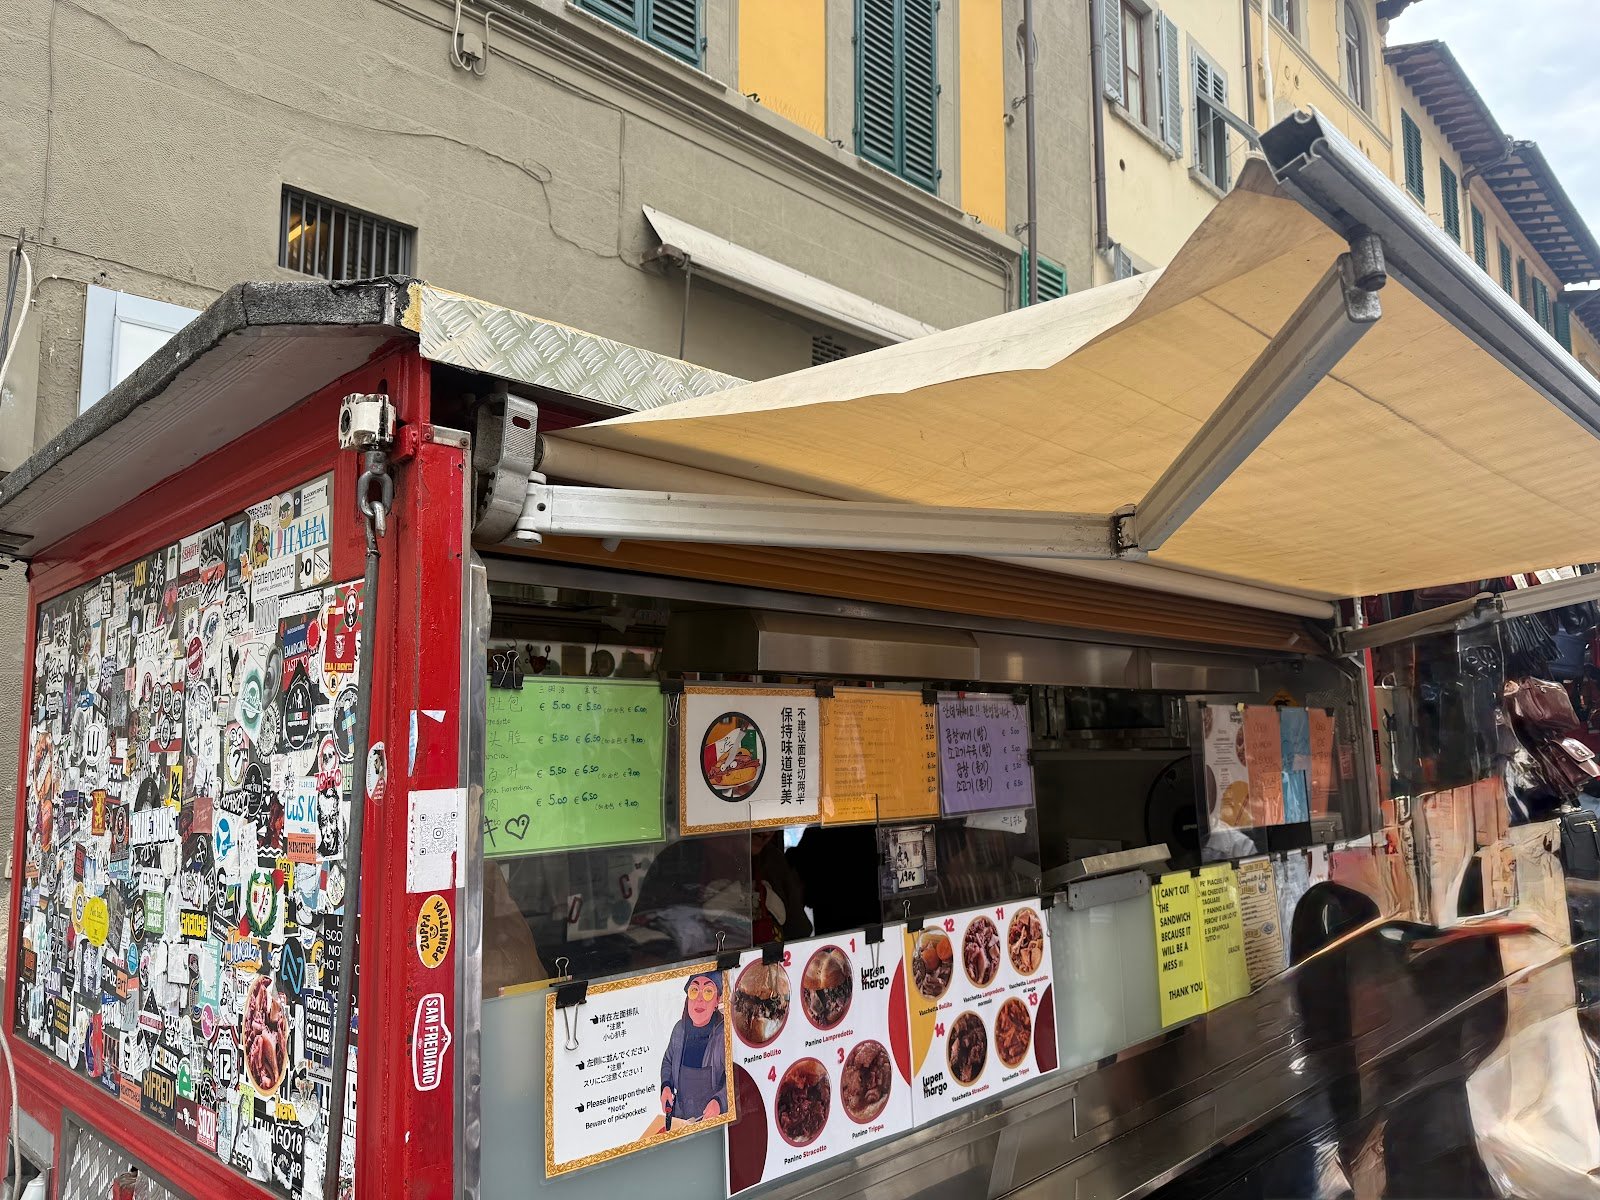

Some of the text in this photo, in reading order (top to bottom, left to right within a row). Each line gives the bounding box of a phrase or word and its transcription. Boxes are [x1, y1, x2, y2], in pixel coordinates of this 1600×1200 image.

[552, 701, 571, 710] 5.00
[586, 702, 602, 711] 5.50
[552, 733, 569, 743] 5.50
[584, 733, 601, 743] 6.50
[781, 707, 793, 805] 保持味道鲜美
[796, 707, 806, 805] 不建议面包切两半
[549, 766, 567, 776] 5.50
[582, 764, 599, 774] 6.50
[548, 794, 568, 805] 5.00
[581, 792, 598, 801] 6.50
[1160, 884, 1190, 898] CAN'T CUT
[995, 907, 1004, 921] 11
[1158, 903, 1169, 913] THE
[943, 918, 955, 933] 12
[1160, 912, 1191, 927] SANDWICH
[420, 900, 449, 962] ZUPPA PRIMITIVA
[1161, 926, 1191, 942] BECAUSE IT
[849, 938, 856, 953] 1
[1162, 941, 1189, 957] WILL BE A
[783, 950, 792, 967] 2
[1162, 959, 1178, 972] MESS
[1168, 981, 1203, 1000] THANK YOU
[306, 995, 331, 1014] ROYAL
[1028, 993, 1038, 1006] 13
[306, 1011, 331, 1026] FOOTBALL
[599, 1007, 640, 1023] 请在左面排队
[306, 1022, 331, 1043] CLUB
[805, 1029, 854, 1048] Panino Lampredotto
[935, 1023, 945, 1038] 14
[422, 998, 439, 1085] SAN FREDIANO
[587, 1046, 650, 1067] 左側に並んでください
[744, 1049, 782, 1065] Panino Bollito
[837, 1047, 845, 1063] 3
[767, 1066, 777, 1082] 4
[143, 1070, 174, 1109] RIFREDI
[586, 1083, 656, 1110] Please line up on the left
[971, 1084, 990, 1095] Stracotto
[585, 1106, 647, 1130] Beware of pickpockets!
[255, 1116, 303, 1154] THIAGO18
[852, 1123, 885, 1139] Panino Trippa
[784, 1145, 827, 1165] Panino Stracotto
